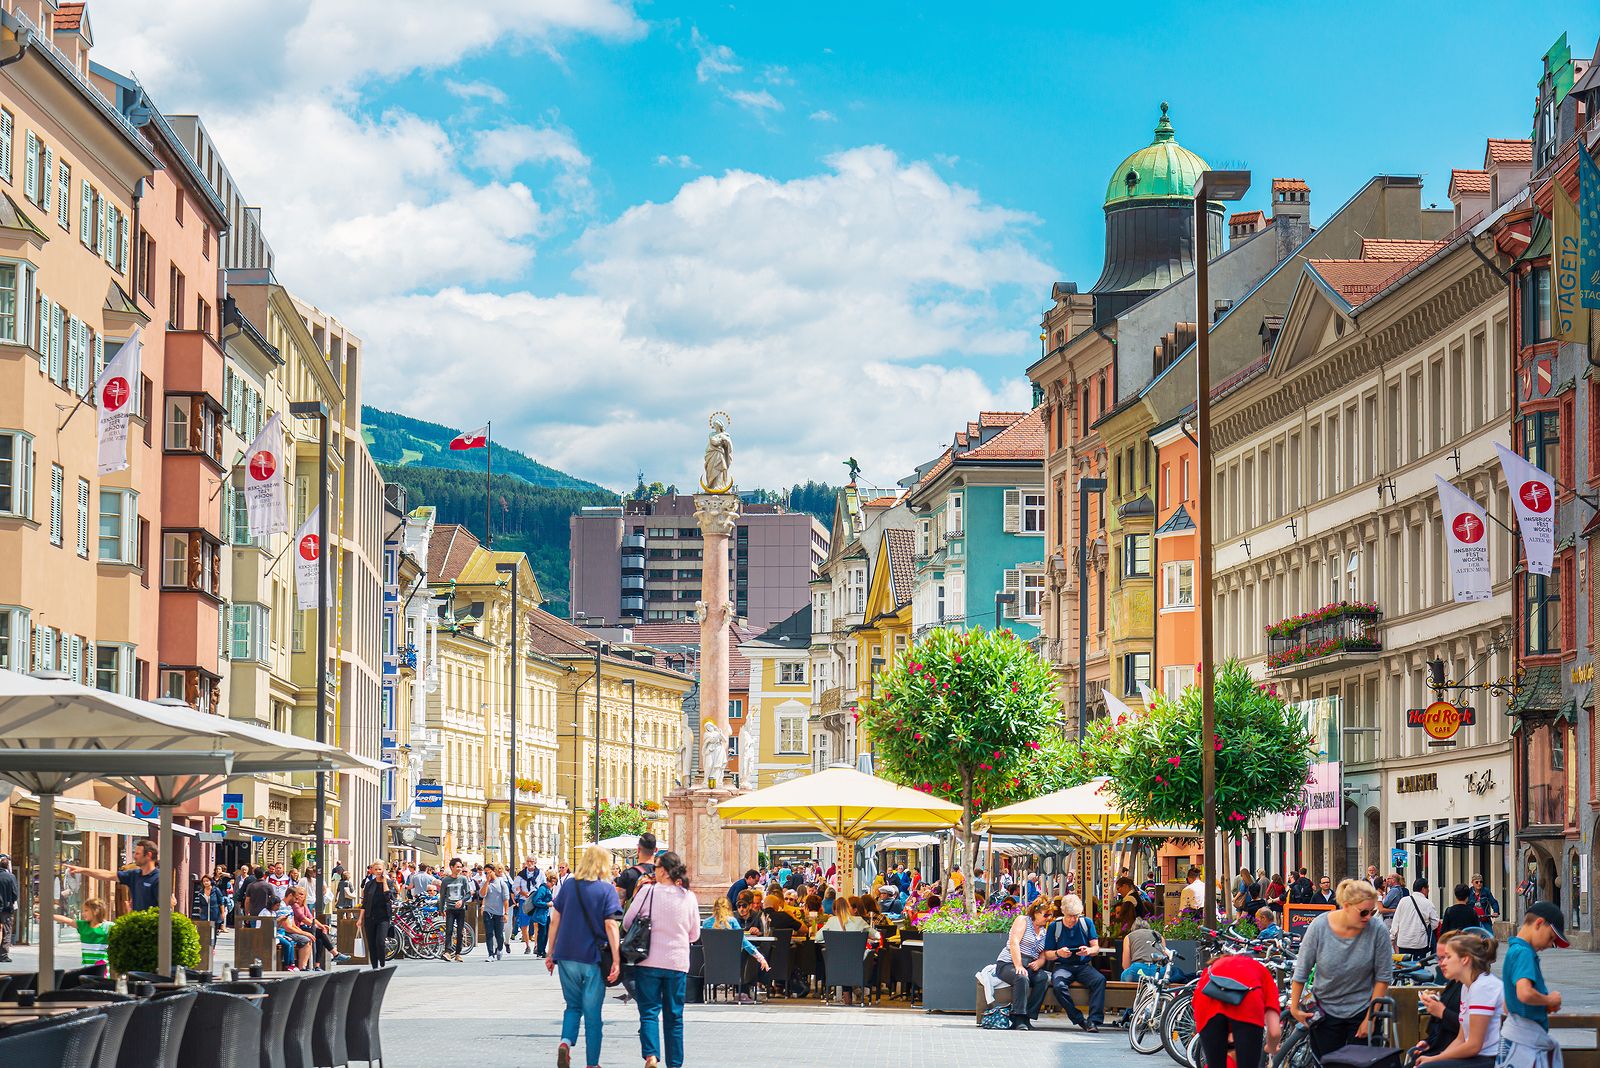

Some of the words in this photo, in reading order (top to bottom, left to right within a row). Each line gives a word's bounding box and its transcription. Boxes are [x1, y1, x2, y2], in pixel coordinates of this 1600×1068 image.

[1557, 236, 1579, 332] STAGE12
[1409, 709, 1441, 724] Hard
[1443, 708, 1473, 724] Rock
